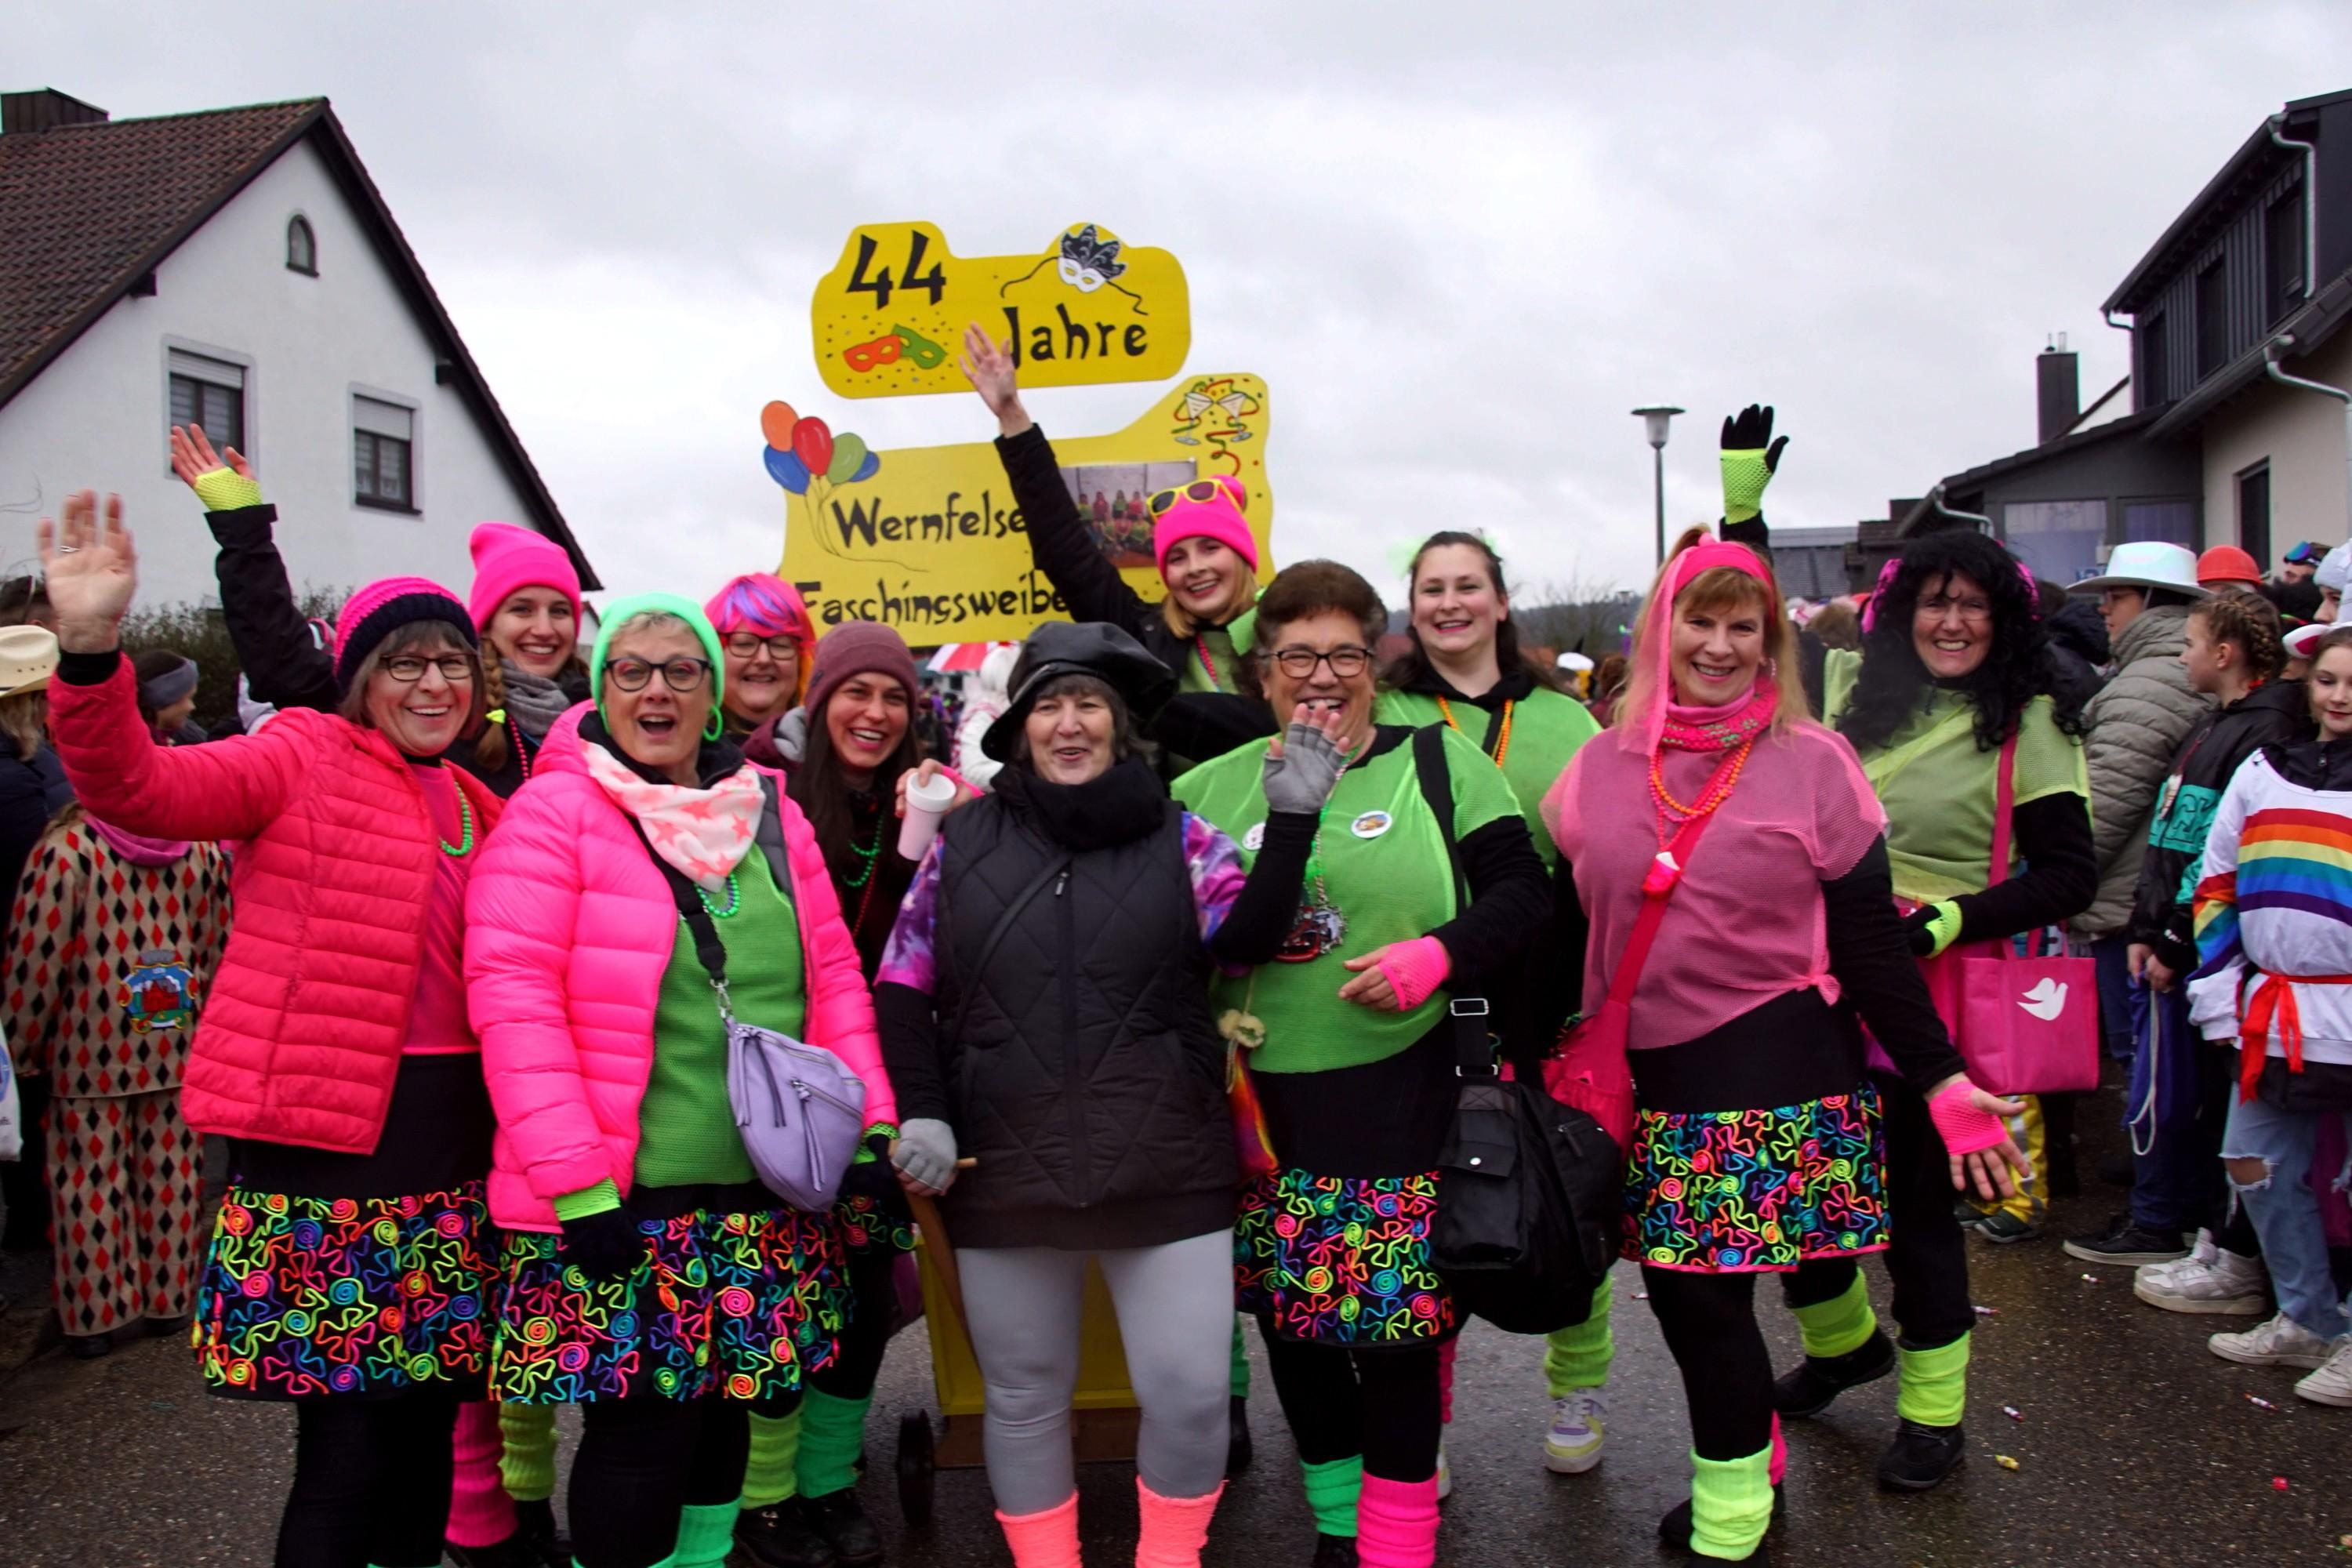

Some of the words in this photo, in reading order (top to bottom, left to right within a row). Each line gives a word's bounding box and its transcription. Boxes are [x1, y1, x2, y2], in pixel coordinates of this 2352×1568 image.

[845, 230, 946, 310] 44
[1002, 303, 1148, 370] Jahre
[831, 489, 1028, 549] Wernfelse
[794, 569, 1068, 626] Faschingsweibe
